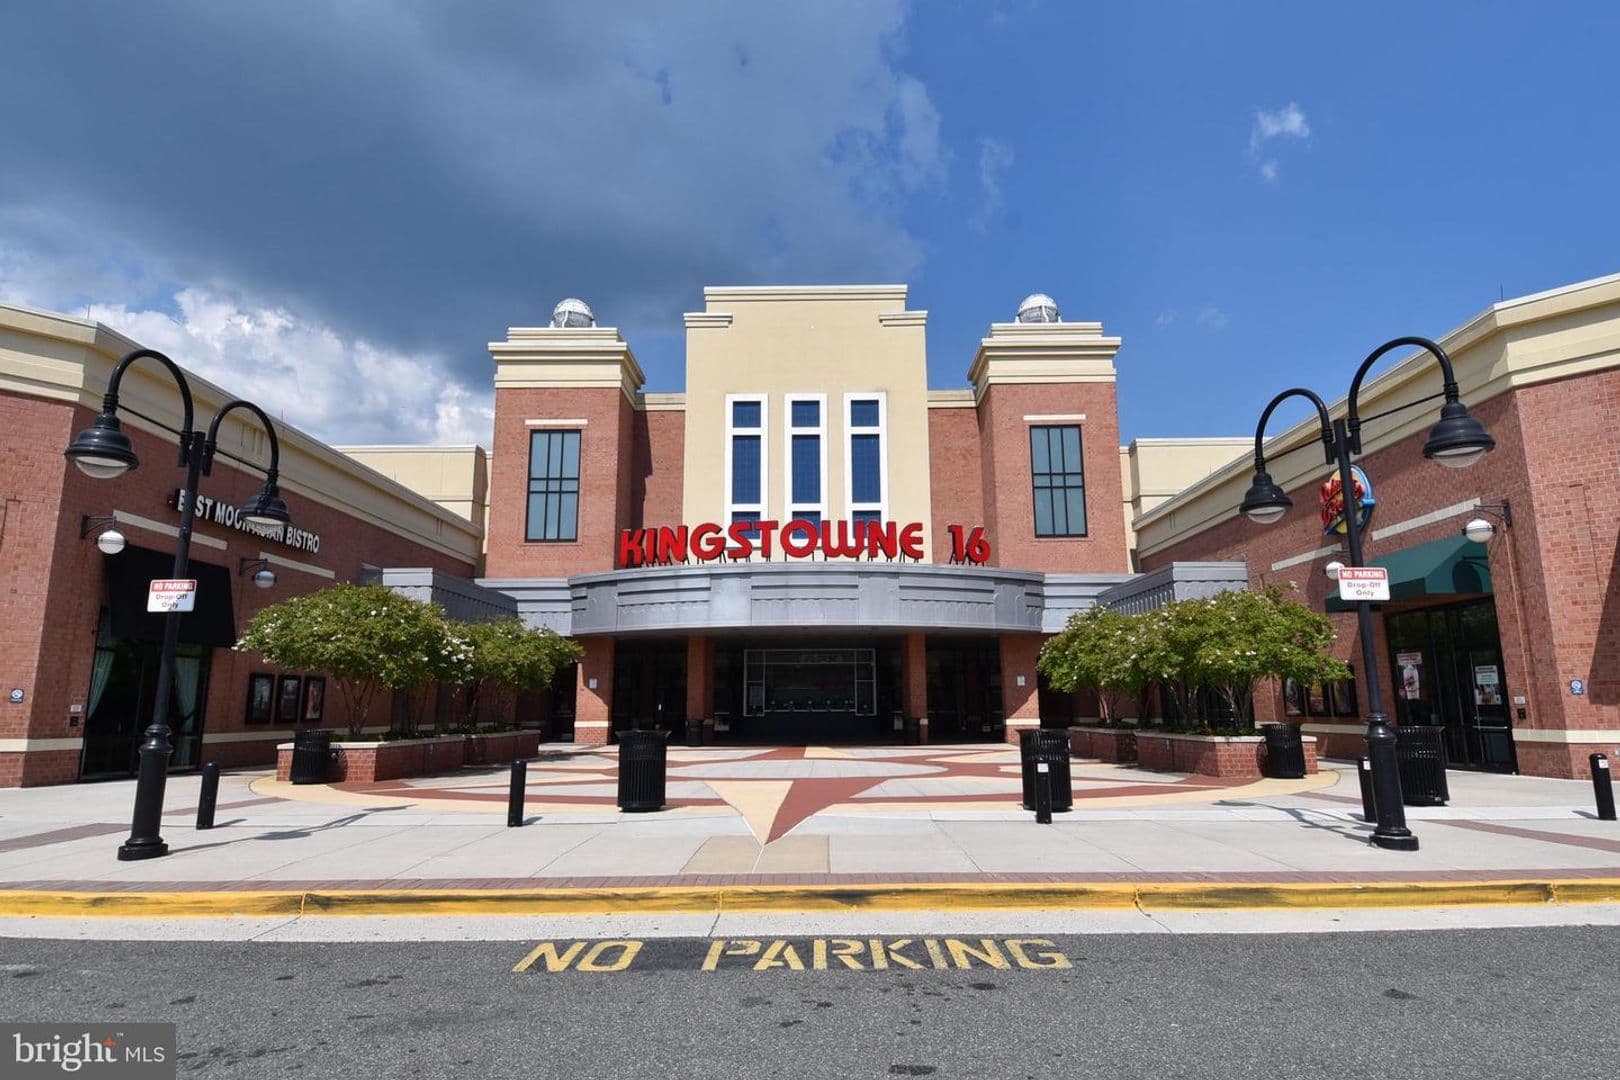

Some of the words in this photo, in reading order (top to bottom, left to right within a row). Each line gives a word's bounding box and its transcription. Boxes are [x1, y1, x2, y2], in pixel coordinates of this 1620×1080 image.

[177, 488, 213, 520] EST
[285, 526, 320, 553] BISTRO
[619, 519, 924, 567] KINGSTOWNE
[947, 524, 991, 563] 16
[1341, 571, 1352, 579] NO
[1354, 571, 1384, 579] PARKING
[153, 582, 163, 590] NO
[164, 582, 193, 590] PARKING
[161, 601, 179, 609] Only
[511, 940, 644, 972] NO
[701, 938, 1073, 971] PARKING
